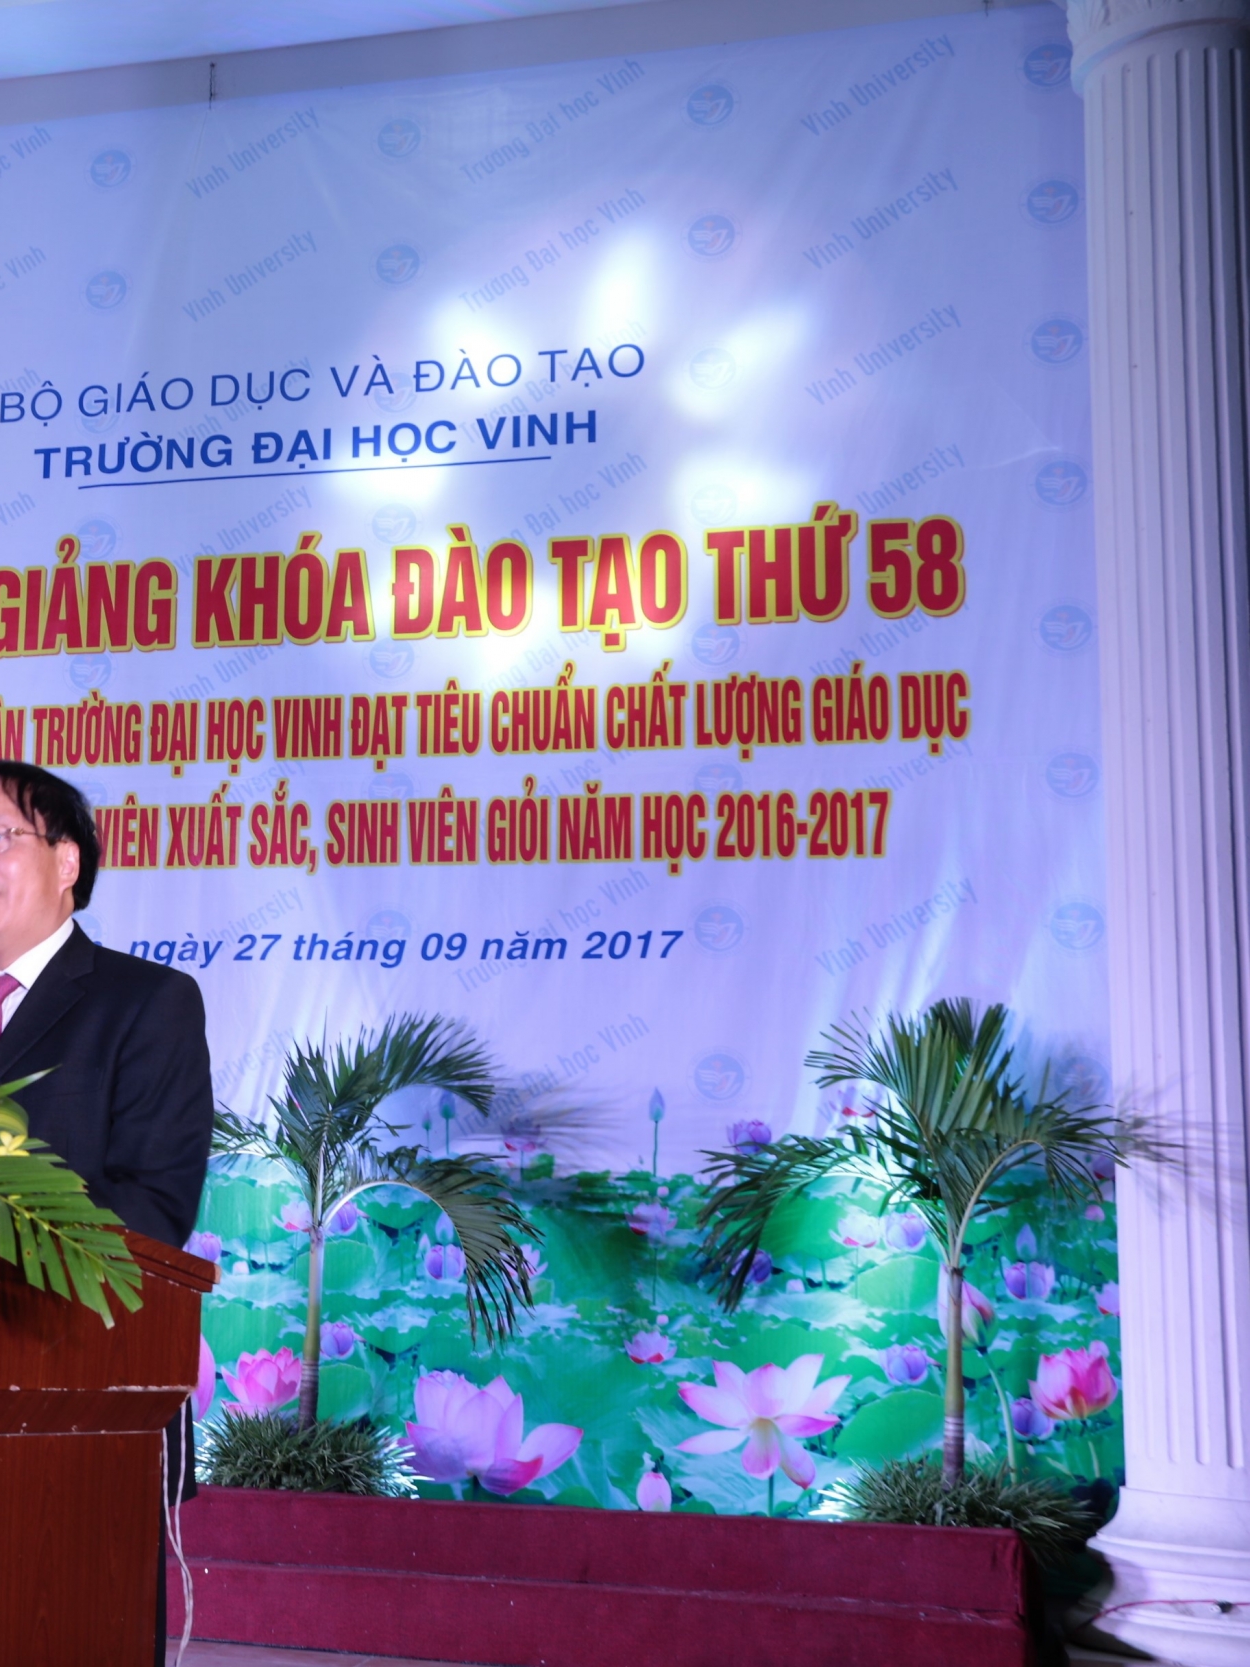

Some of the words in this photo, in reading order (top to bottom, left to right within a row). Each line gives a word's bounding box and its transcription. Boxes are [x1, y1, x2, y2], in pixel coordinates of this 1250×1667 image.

[596, 58, 645, 95] Vinh
[800, 100, 852, 137] Vinh
[10, 125, 53, 160] Vinh
[185, 165, 229, 199] Vinh
[596, 188, 646, 224] Vinh
[4, 244, 48, 281] Vinh
[802, 233, 854, 271] Vinh
[182, 288, 226, 323] Vinh
[0, 379, 63, 427] BỘ
[78, 370, 194, 418] GIÁO
[211, 367, 311, 411] DỤC
[330, 354, 395, 398] VÀ
[413, 348, 523, 394] ĐÀO
[538, 343, 646, 388] TẠO
[804, 367, 857, 406] Vinh
[33, 430, 233, 480] TRƯỜNG
[251, 427, 332, 470] ĐẠI
[351, 419, 458, 463] HỌC
[476, 409, 597, 450] VINH
[597, 452, 648, 489] Vinh
[194, 534, 370, 644] KHÓA
[392, 526, 528, 635] ĐÀO
[551, 533, 683, 647] TẠO
[707, 504, 853, 621] THỨ
[870, 518, 960, 614] 58
[32, 690, 143, 766] TRƯỜNG
[149, 701, 199, 776] ĐẠI
[206, 698, 265, 775] HỌC
[273, 696, 343, 759] VINH
[350, 694, 409, 771] ĐẠT
[416, 679, 482, 755] TIÊU
[490, 662, 596, 754] CHUẨN
[606, 661, 687, 750] CHẤT
[696, 674, 803, 760] LƯỢNG
[812, 662, 891, 743] GIÁO
[900, 672, 969, 754] DỤC
[94, 794, 160, 868] VIÊN
[166, 782, 243, 868] XUẤT
[249, 780, 318, 873] SẮC,
[326, 801, 400, 866] SINH
[408, 786, 478, 864] VIÊN
[487, 776, 550, 863] GIỎI
[558, 784, 633, 861] NĂM
[642, 792, 707, 874] HỌC
[716, 790, 890, 859] 2016-2017
[599, 868, 650, 906] Vinh
[129, 932, 224, 968] ngày
[233, 933, 282, 962] 27
[292, 931, 407, 969] tháng
[420, 932, 468, 962] 09
[480, 930, 569, 961] năm
[581, 929, 684, 961] 2017
[814, 938, 870, 978] Vinh
[597, 1012, 649, 1052] Vinh
